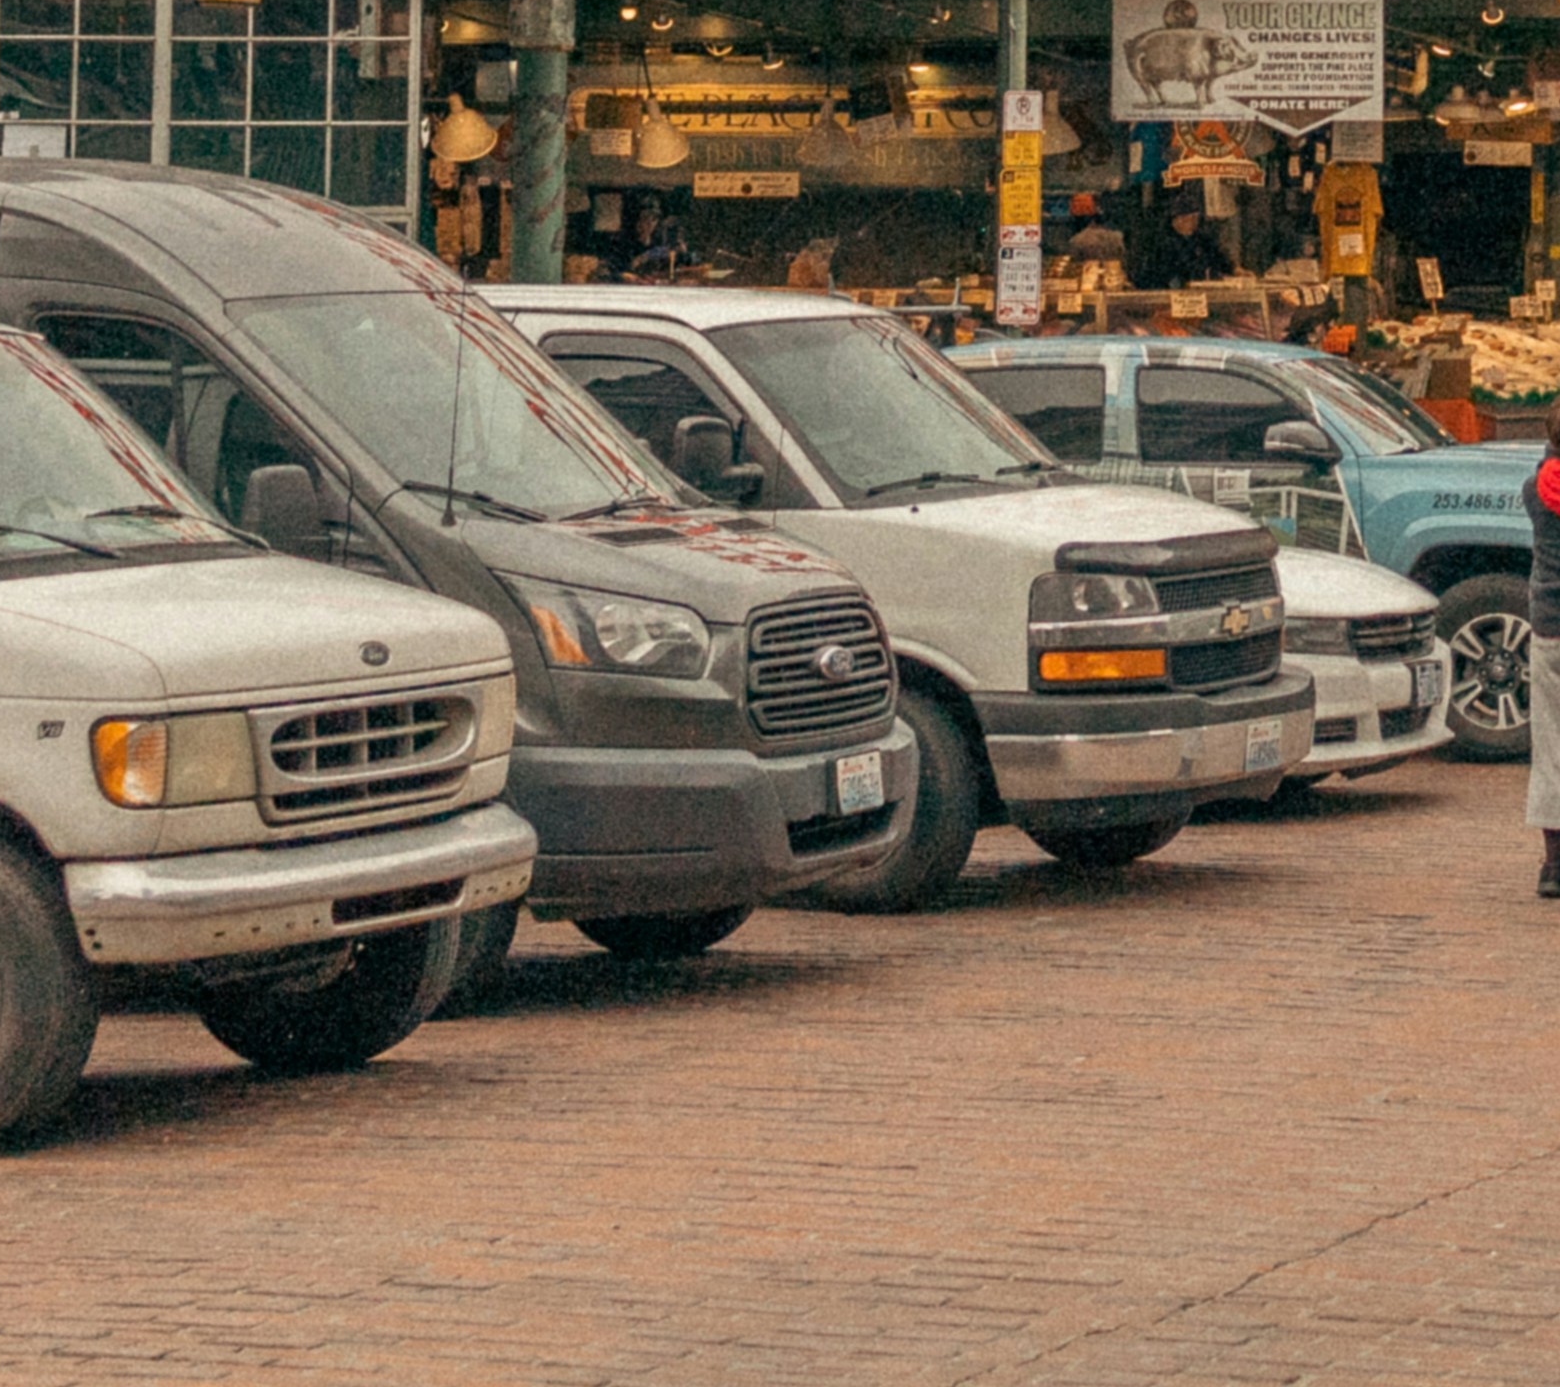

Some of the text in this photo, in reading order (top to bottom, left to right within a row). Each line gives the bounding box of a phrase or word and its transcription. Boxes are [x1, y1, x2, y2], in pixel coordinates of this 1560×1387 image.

[1222, 2, 1377, 30] YOUR CHANGE
[1248, 32, 1376, 43] CHANGES LIVES!
[1267, 51, 1375, 61] YOUR GENEROSITY
[1249, 99, 1350, 111] DONATE HERE!
